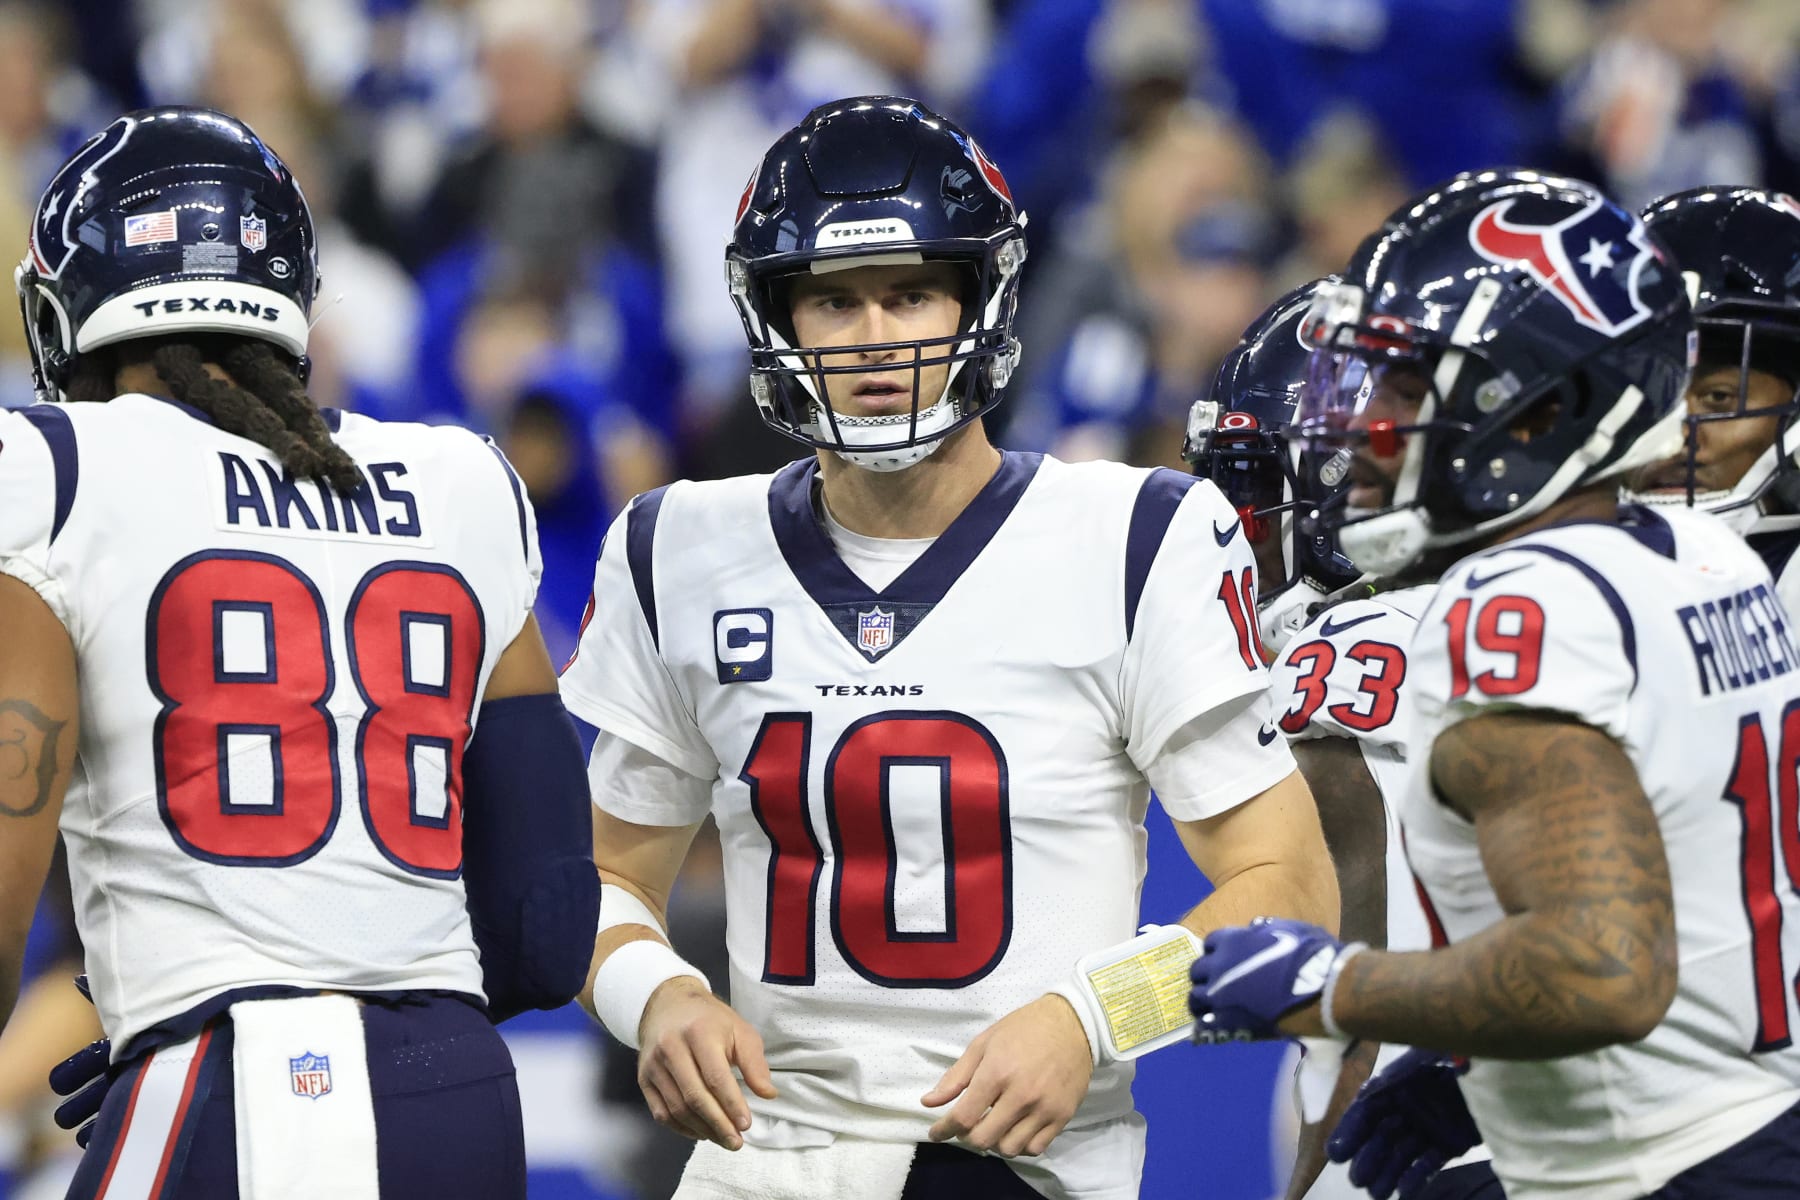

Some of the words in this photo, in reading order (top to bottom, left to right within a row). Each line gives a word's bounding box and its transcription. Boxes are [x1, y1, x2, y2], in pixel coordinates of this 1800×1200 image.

[245, 230, 264, 246] NFL
[830, 225, 897, 239] TEXANS
[134, 297, 279, 322] TEXANS
[217, 451, 421, 537] AKINS
[716, 613, 767, 664] C
[862, 629, 888, 647] NFL
[1444, 595, 1545, 699] 19
[1676, 583, 1800, 696] RODGER
[815, 684, 924, 697] TEXANS
[1278, 639, 1407, 732] 33
[146, 548, 485, 880] 88
[738, 710, 1013, 989] 10
[295, 1073, 328, 1095] NFL
